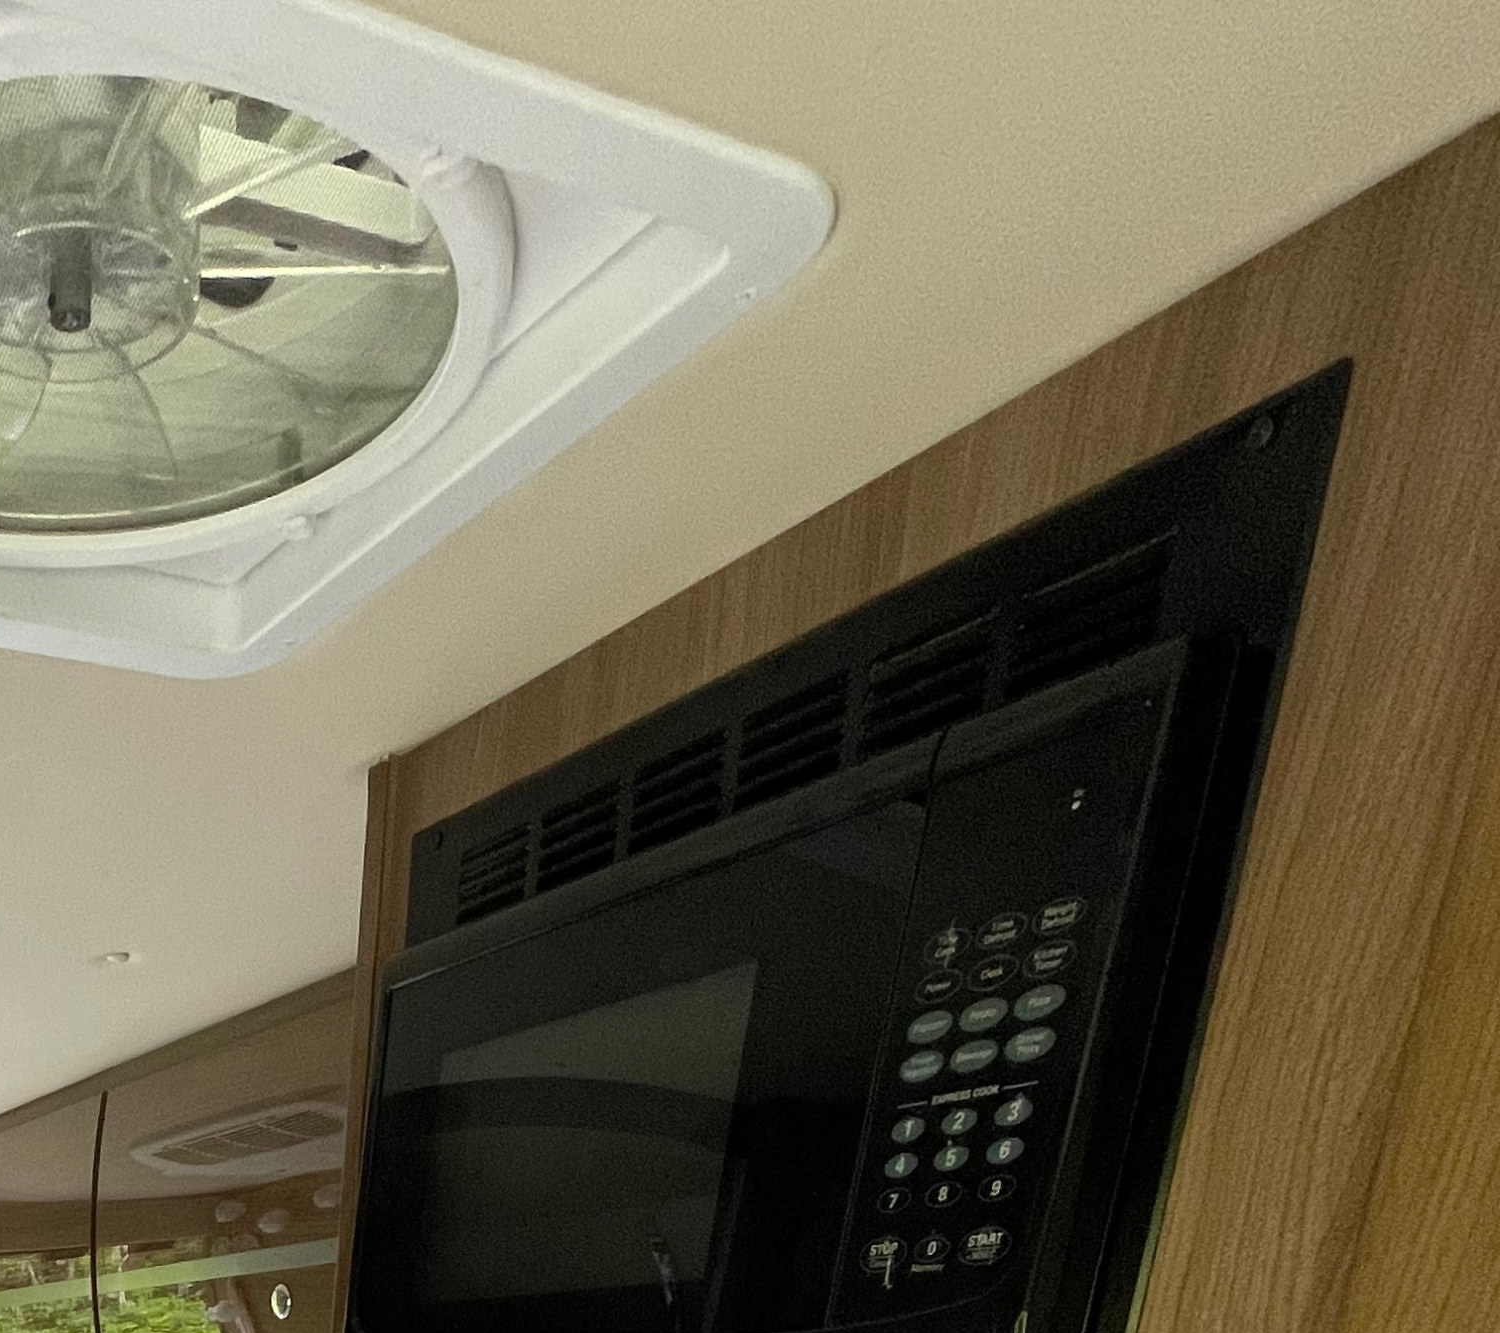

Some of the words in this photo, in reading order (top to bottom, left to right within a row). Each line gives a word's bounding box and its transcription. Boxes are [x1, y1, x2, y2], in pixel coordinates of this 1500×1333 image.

[905, 1120, 915, 1138] 1
[952, 1111, 965, 1130] 2
[1007, 1101, 1022, 1121] 3
[895, 1152, 906, 1174] 4
[945, 1149, 959, 1167] 5
[999, 1140, 1011, 1159] 6
[889, 1193, 898, 1209] 7
[938, 1185, 949, 1202] 8
[990, 1179, 1002, 1196] 9
[869, 1241, 898, 1256] STOP
[927, 1241, 937, 1256] 0
[967, 1232, 1004, 1248] START
